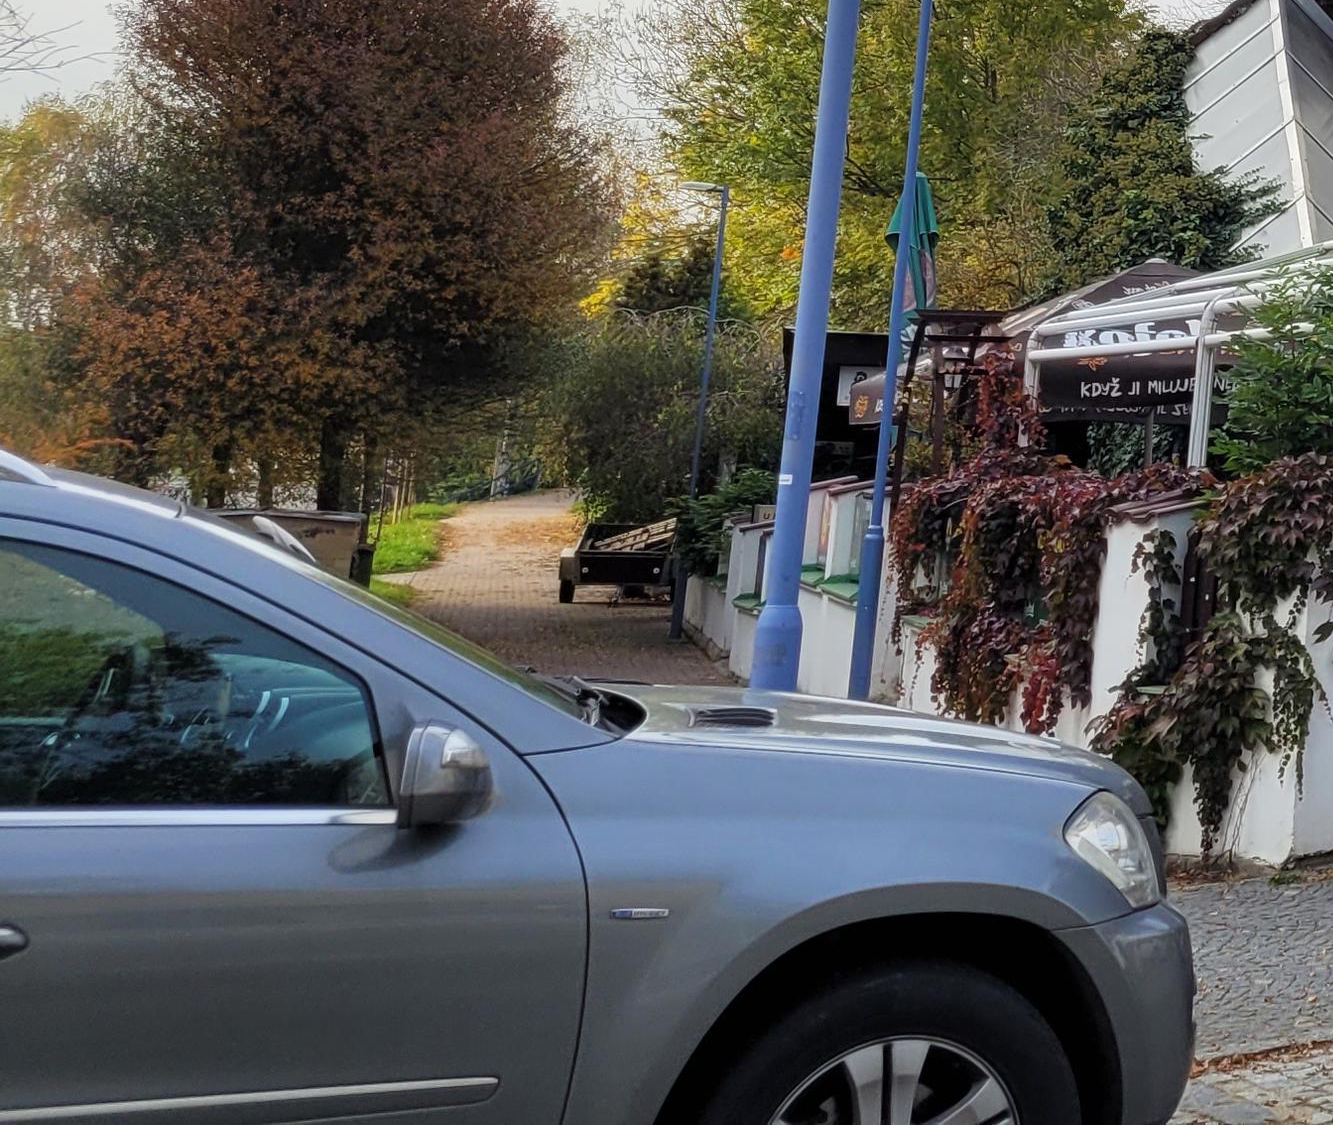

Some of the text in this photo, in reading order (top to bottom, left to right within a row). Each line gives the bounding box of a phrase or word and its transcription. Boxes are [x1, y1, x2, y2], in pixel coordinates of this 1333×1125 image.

[1080, 377, 1122, 398] KDYŽ
[1128, 382, 1140, 396] JI
[1148, 378, 1196, 395] MILUJE
